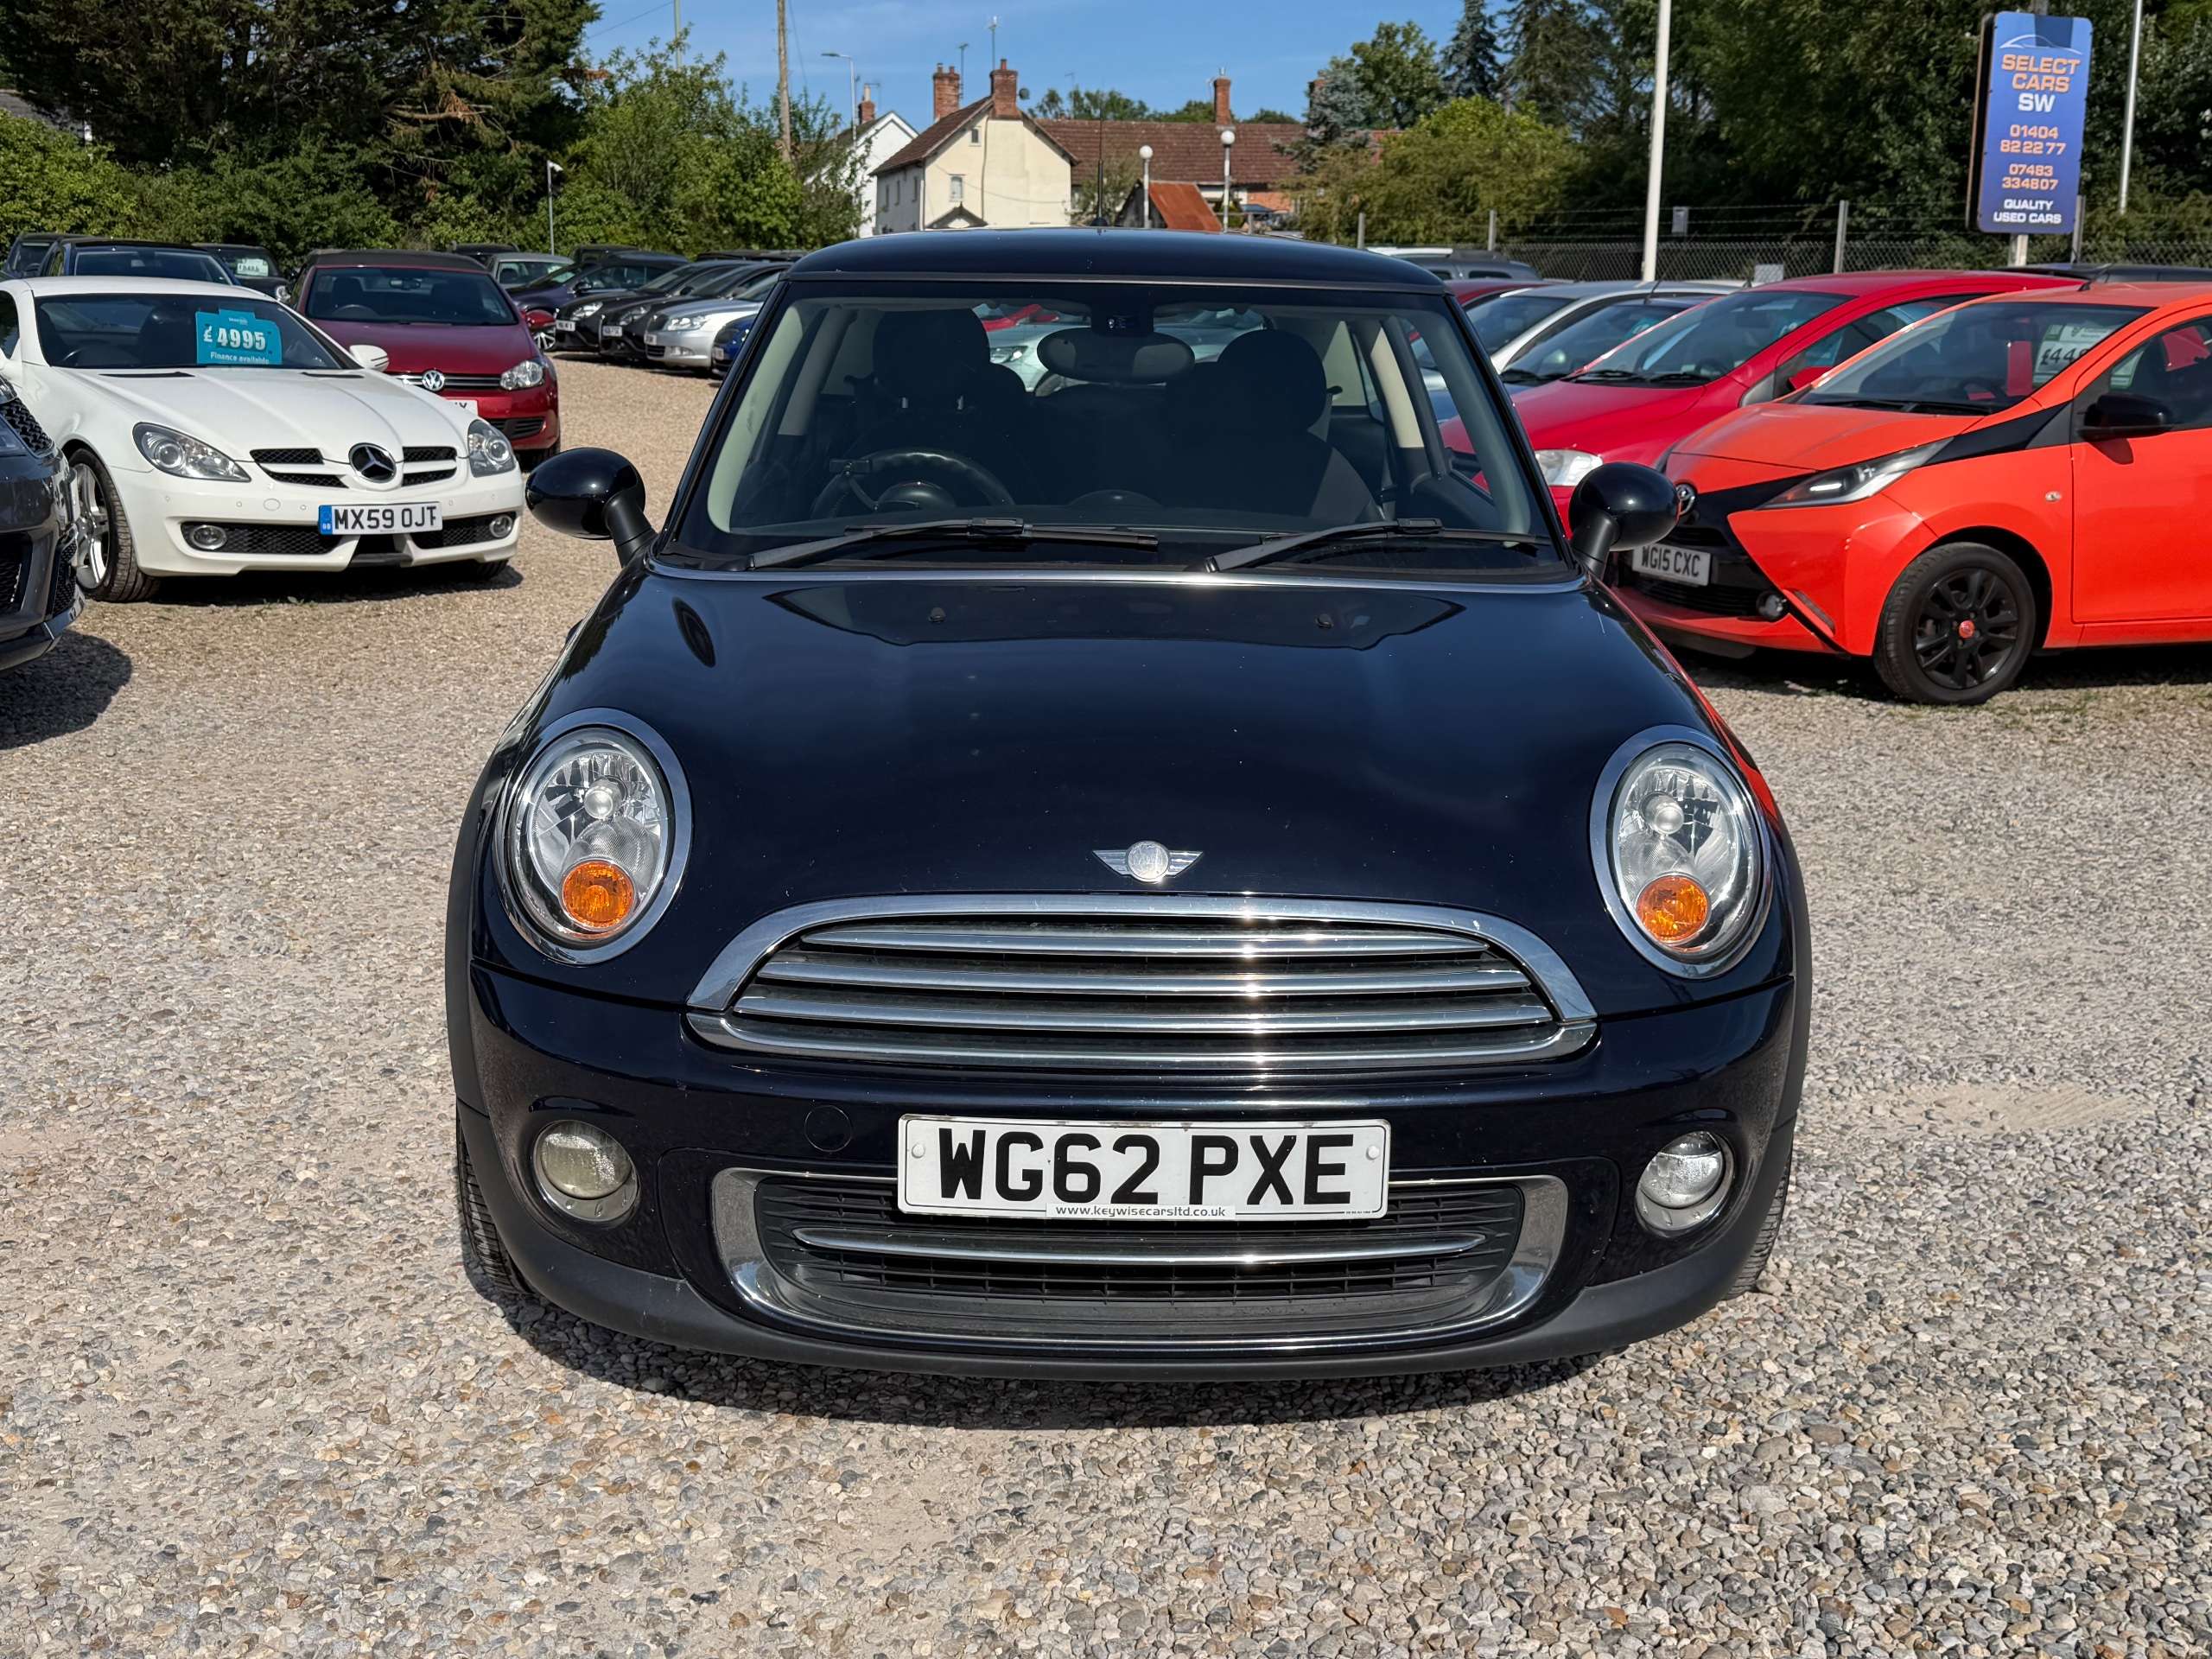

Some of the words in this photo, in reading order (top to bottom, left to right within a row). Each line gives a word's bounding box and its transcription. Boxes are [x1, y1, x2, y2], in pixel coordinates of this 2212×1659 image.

[2001, 54, 2081, 74] SELECT
[2012, 73, 2070, 92] CARS
[2018, 92, 2056, 112] SW
[2010, 124, 2059, 139] 01404
[2009, 163, 2054, 176] 07483
[2001, 176, 2059, 190] 334807
[2004, 199, 2054, 211] QUALITY
[1993, 212, 2026, 224] USED
[2029, 213, 2063, 225] CARS
[210, 351, 238, 361] Finance
[238, 355, 270, 364] available
[334, 509, 395, 530] MX59
[401, 506, 436, 528] OJT
[1641, 546, 1671, 571] WG15
[1673, 551, 1700, 577] CXC
[938, 1127, 1160, 1205] WG62
[1189, 1133, 1354, 1206] PXE
[1056, 1205, 1226, 1217] www.keywisecarsltd.co.uk
